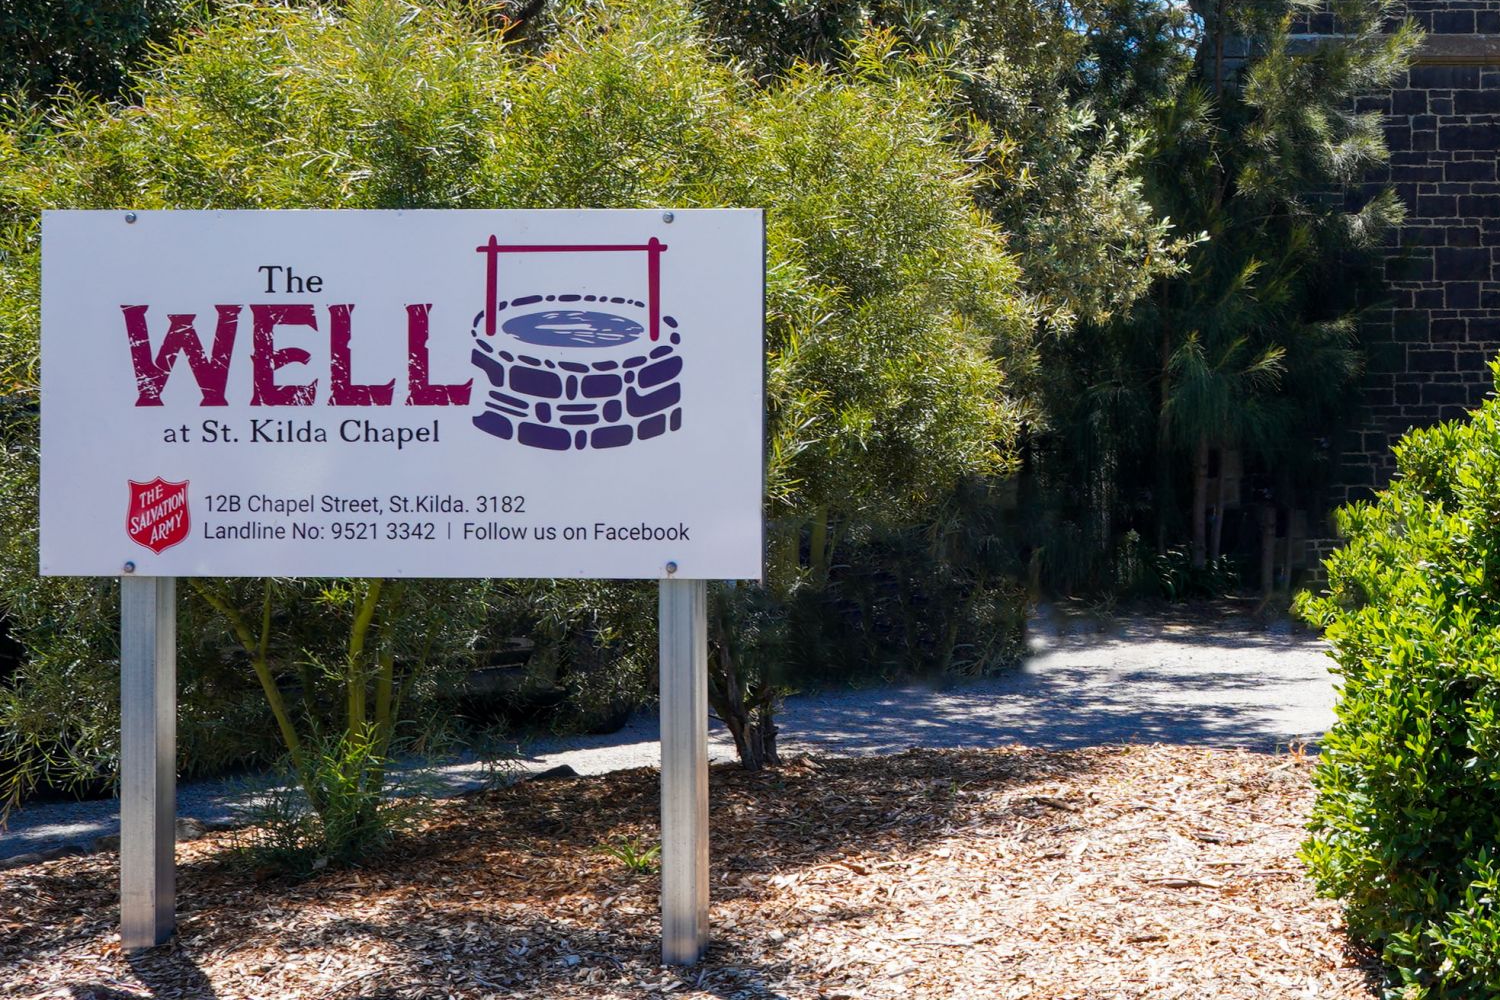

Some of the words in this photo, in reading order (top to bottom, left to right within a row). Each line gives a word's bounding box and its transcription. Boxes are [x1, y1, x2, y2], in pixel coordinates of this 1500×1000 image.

[258, 266, 323, 293] The
[120, 303, 473, 406] WELL
[164, 425, 190, 442] at
[202, 420, 238, 442] St.
[250, 419, 327, 442] Kilda
[340, 420, 439, 450] Chapel
[139, 484, 164, 508] THE
[205, 495, 241, 512] 12B
[248, 495, 314, 516] Chapel
[321, 495, 383, 515] Street,
[476, 496, 525, 513] 3182
[130, 487, 185, 535] SALVATION
[149, 509, 183, 545] ARMY
[204, 521, 285, 539] Landline
[293, 522, 324, 539] No:
[331, 522, 376, 539] 9521
[387, 523, 435, 540] 3342
[464, 522, 527, 540] Follow
[534, 527, 556, 540] us
[563, 527, 586, 540] on
[595, 523, 689, 540] Facebook
